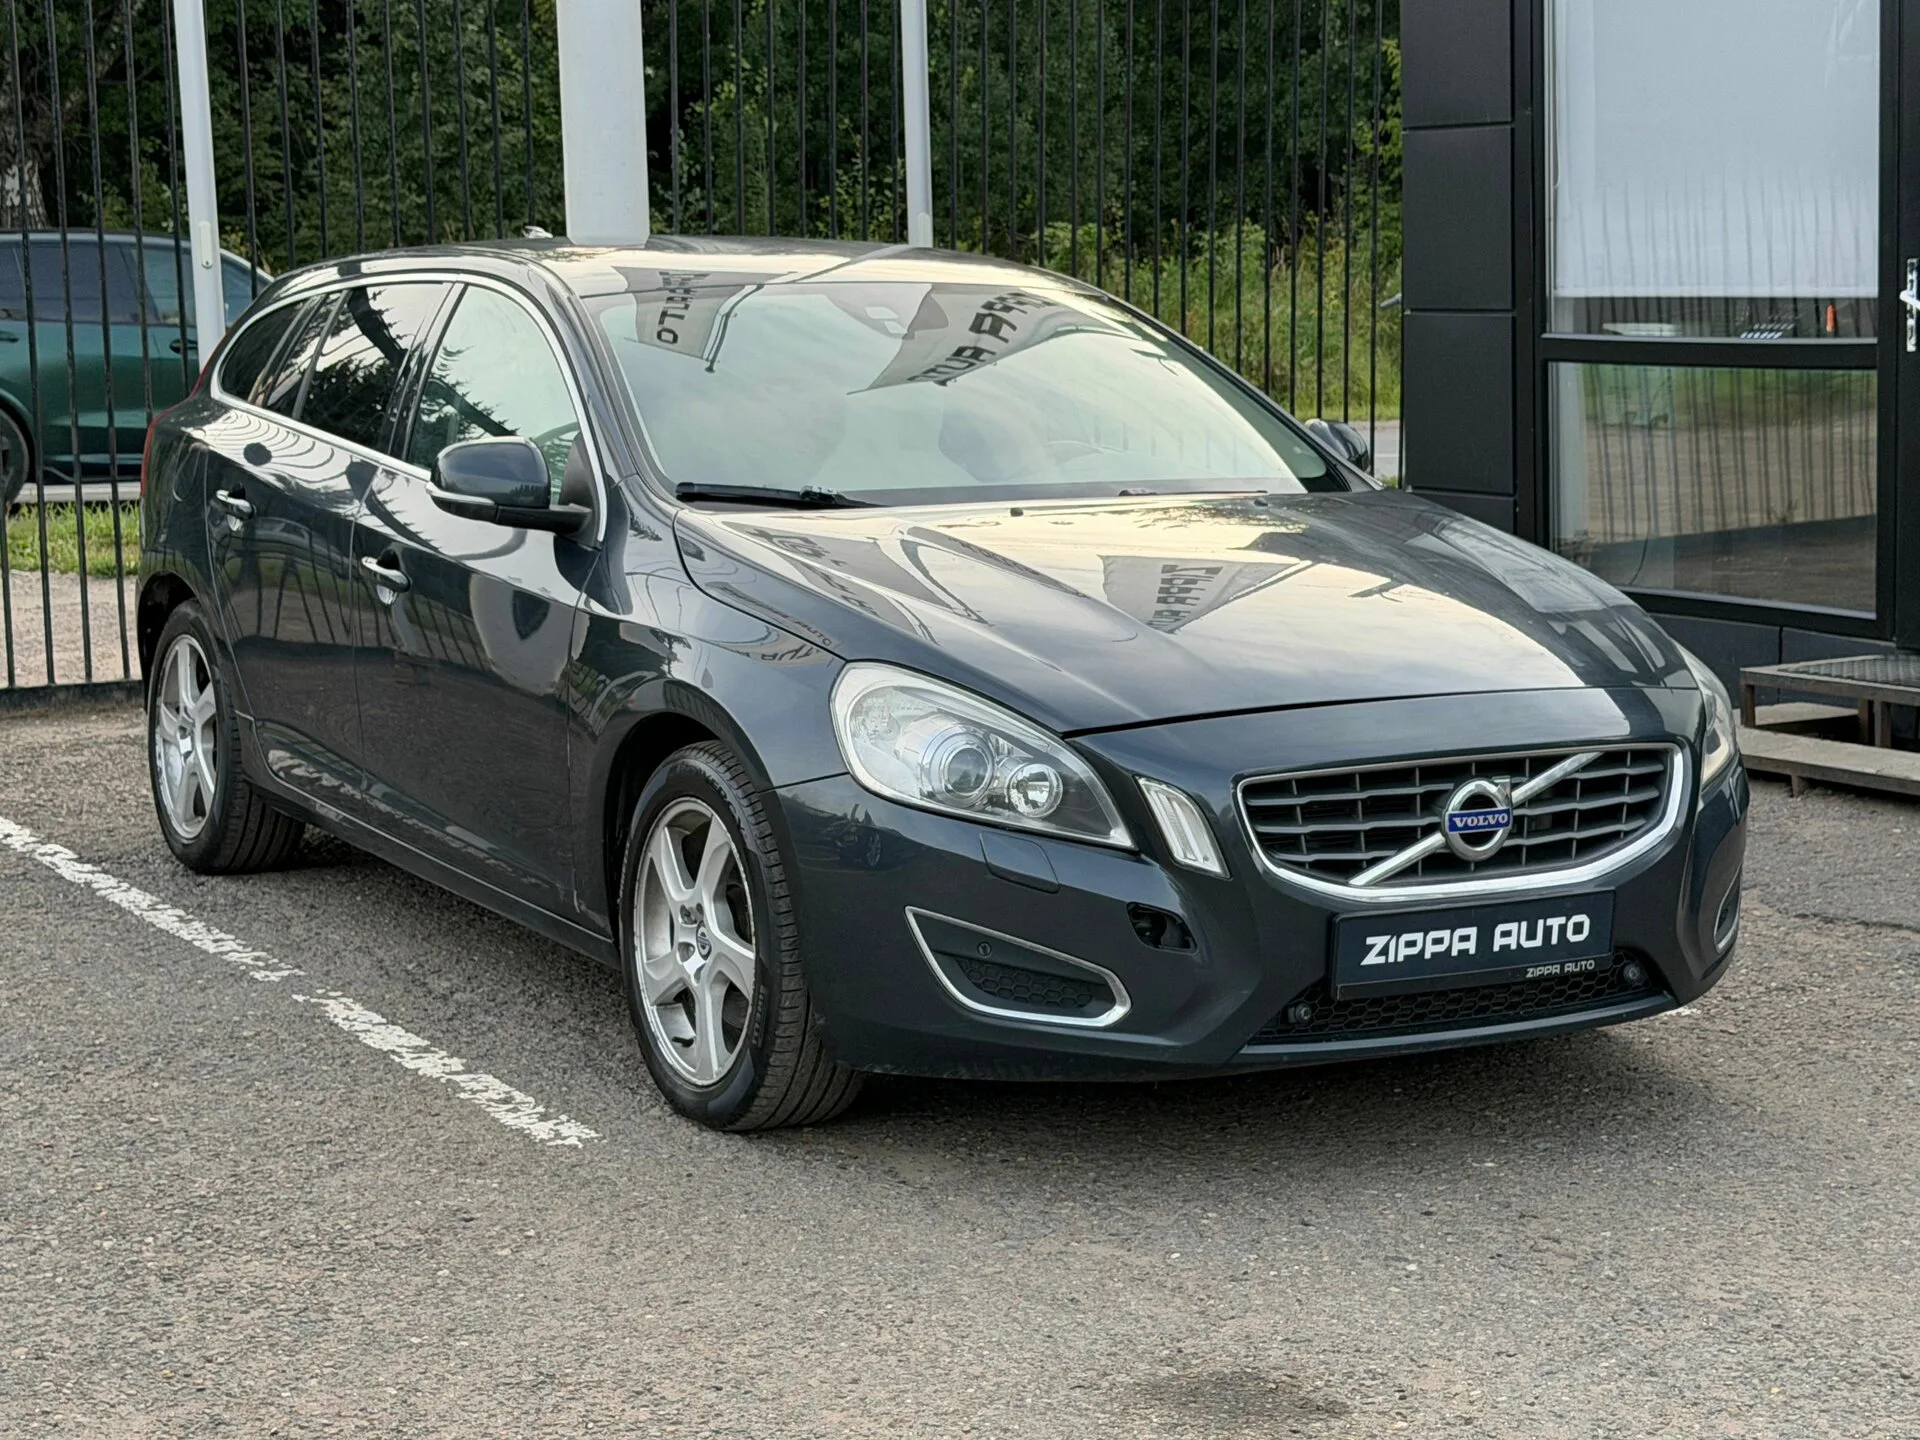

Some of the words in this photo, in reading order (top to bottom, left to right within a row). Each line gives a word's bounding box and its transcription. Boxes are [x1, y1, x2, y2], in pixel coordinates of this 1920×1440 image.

[1453, 813, 1508, 828] VOLVO
[1360, 926, 1478, 966] ZIPPA
[1492, 914, 1590, 952] AUTO
[1526, 964, 1561, 978] ZIPPA
[1564, 960, 1595, 974] AUTO
